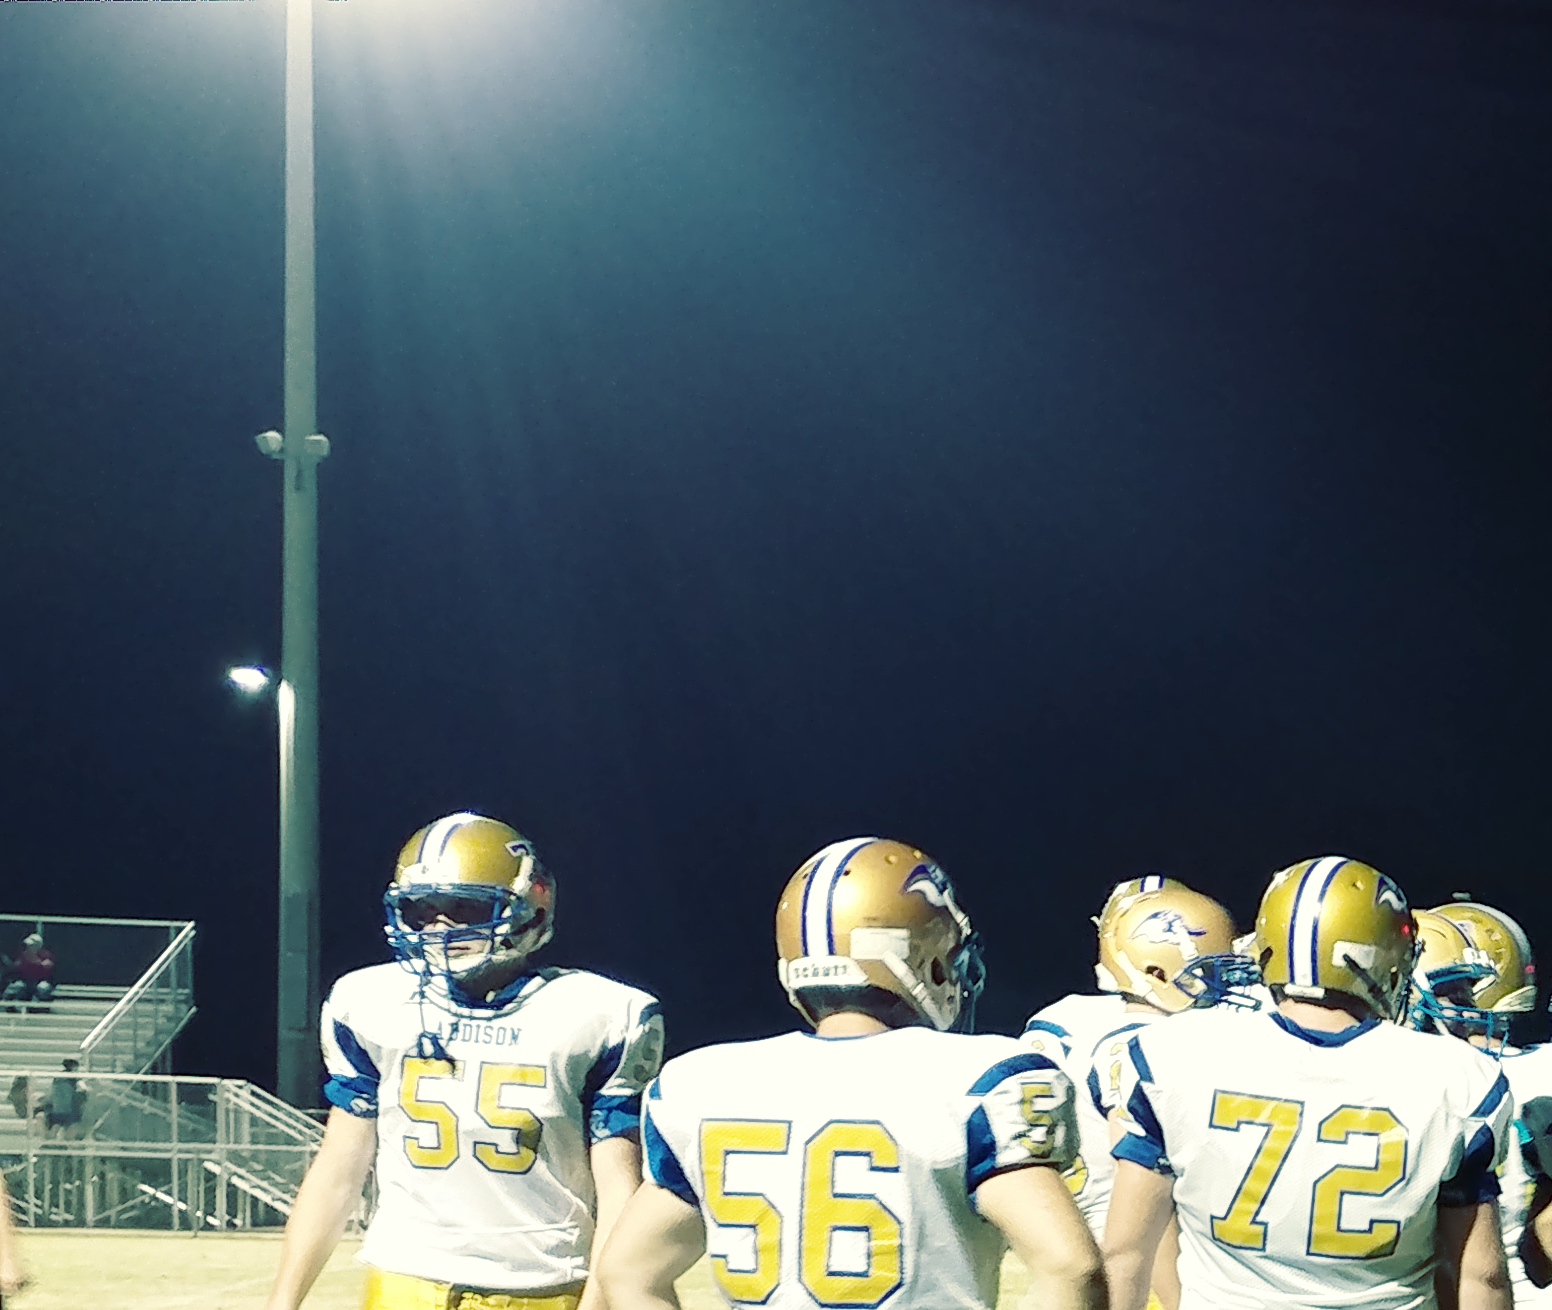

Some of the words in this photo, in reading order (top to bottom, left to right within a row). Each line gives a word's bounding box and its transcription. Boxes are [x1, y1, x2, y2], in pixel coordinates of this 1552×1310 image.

[397, 1055, 548, 1175] 55
[1208, 1088, 1410, 1260] 72
[699, 1118, 905, 1310] 56
